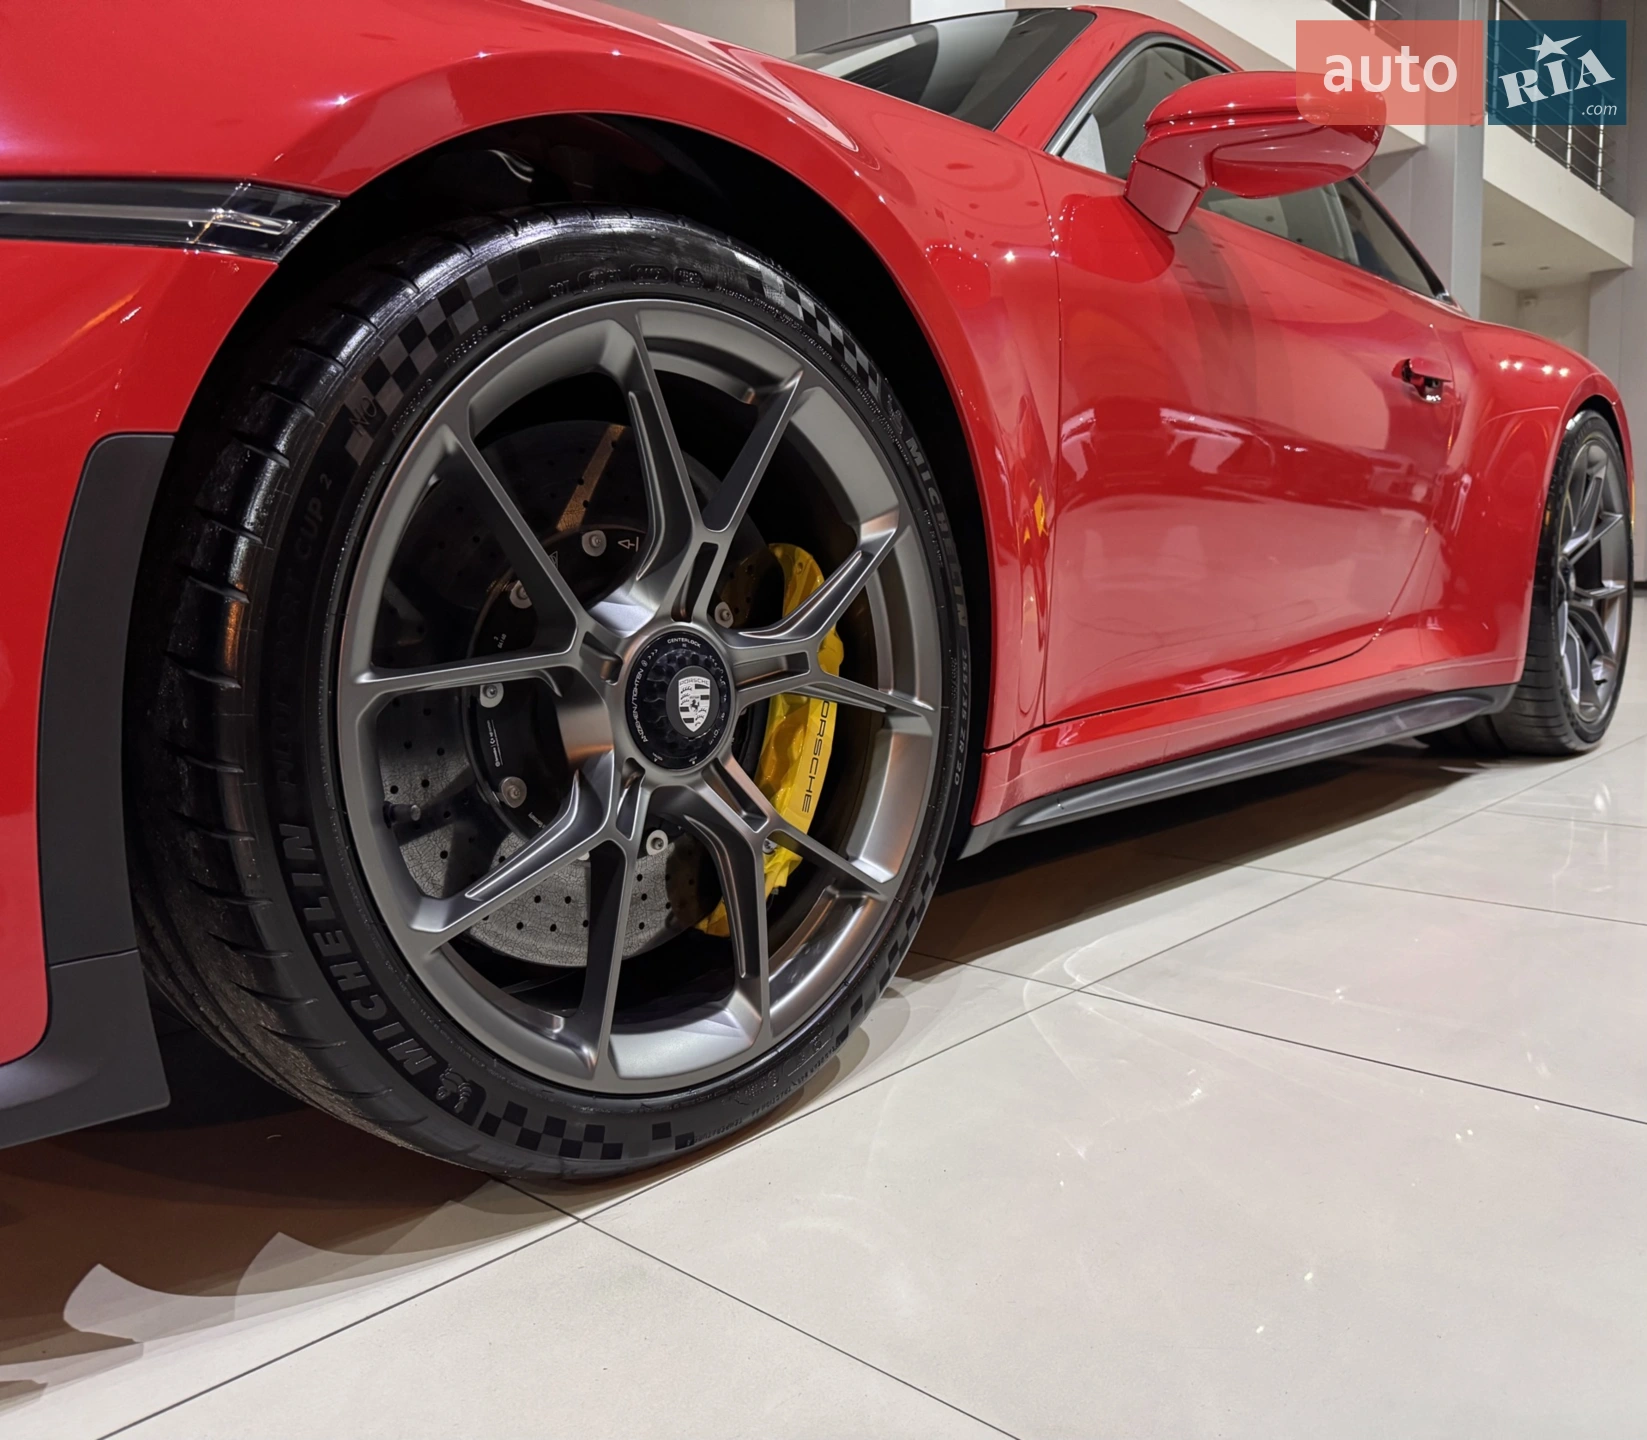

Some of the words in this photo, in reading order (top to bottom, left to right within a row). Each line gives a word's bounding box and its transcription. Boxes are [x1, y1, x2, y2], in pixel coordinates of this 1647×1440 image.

[318, 472, 333, 491] 2
[905, 436, 968, 628] MICHELIN
[801, 700, 831, 814] ORSCHE
[953, 759, 963, 786] 20
[279, 823, 438, 1077] MICHELIN
